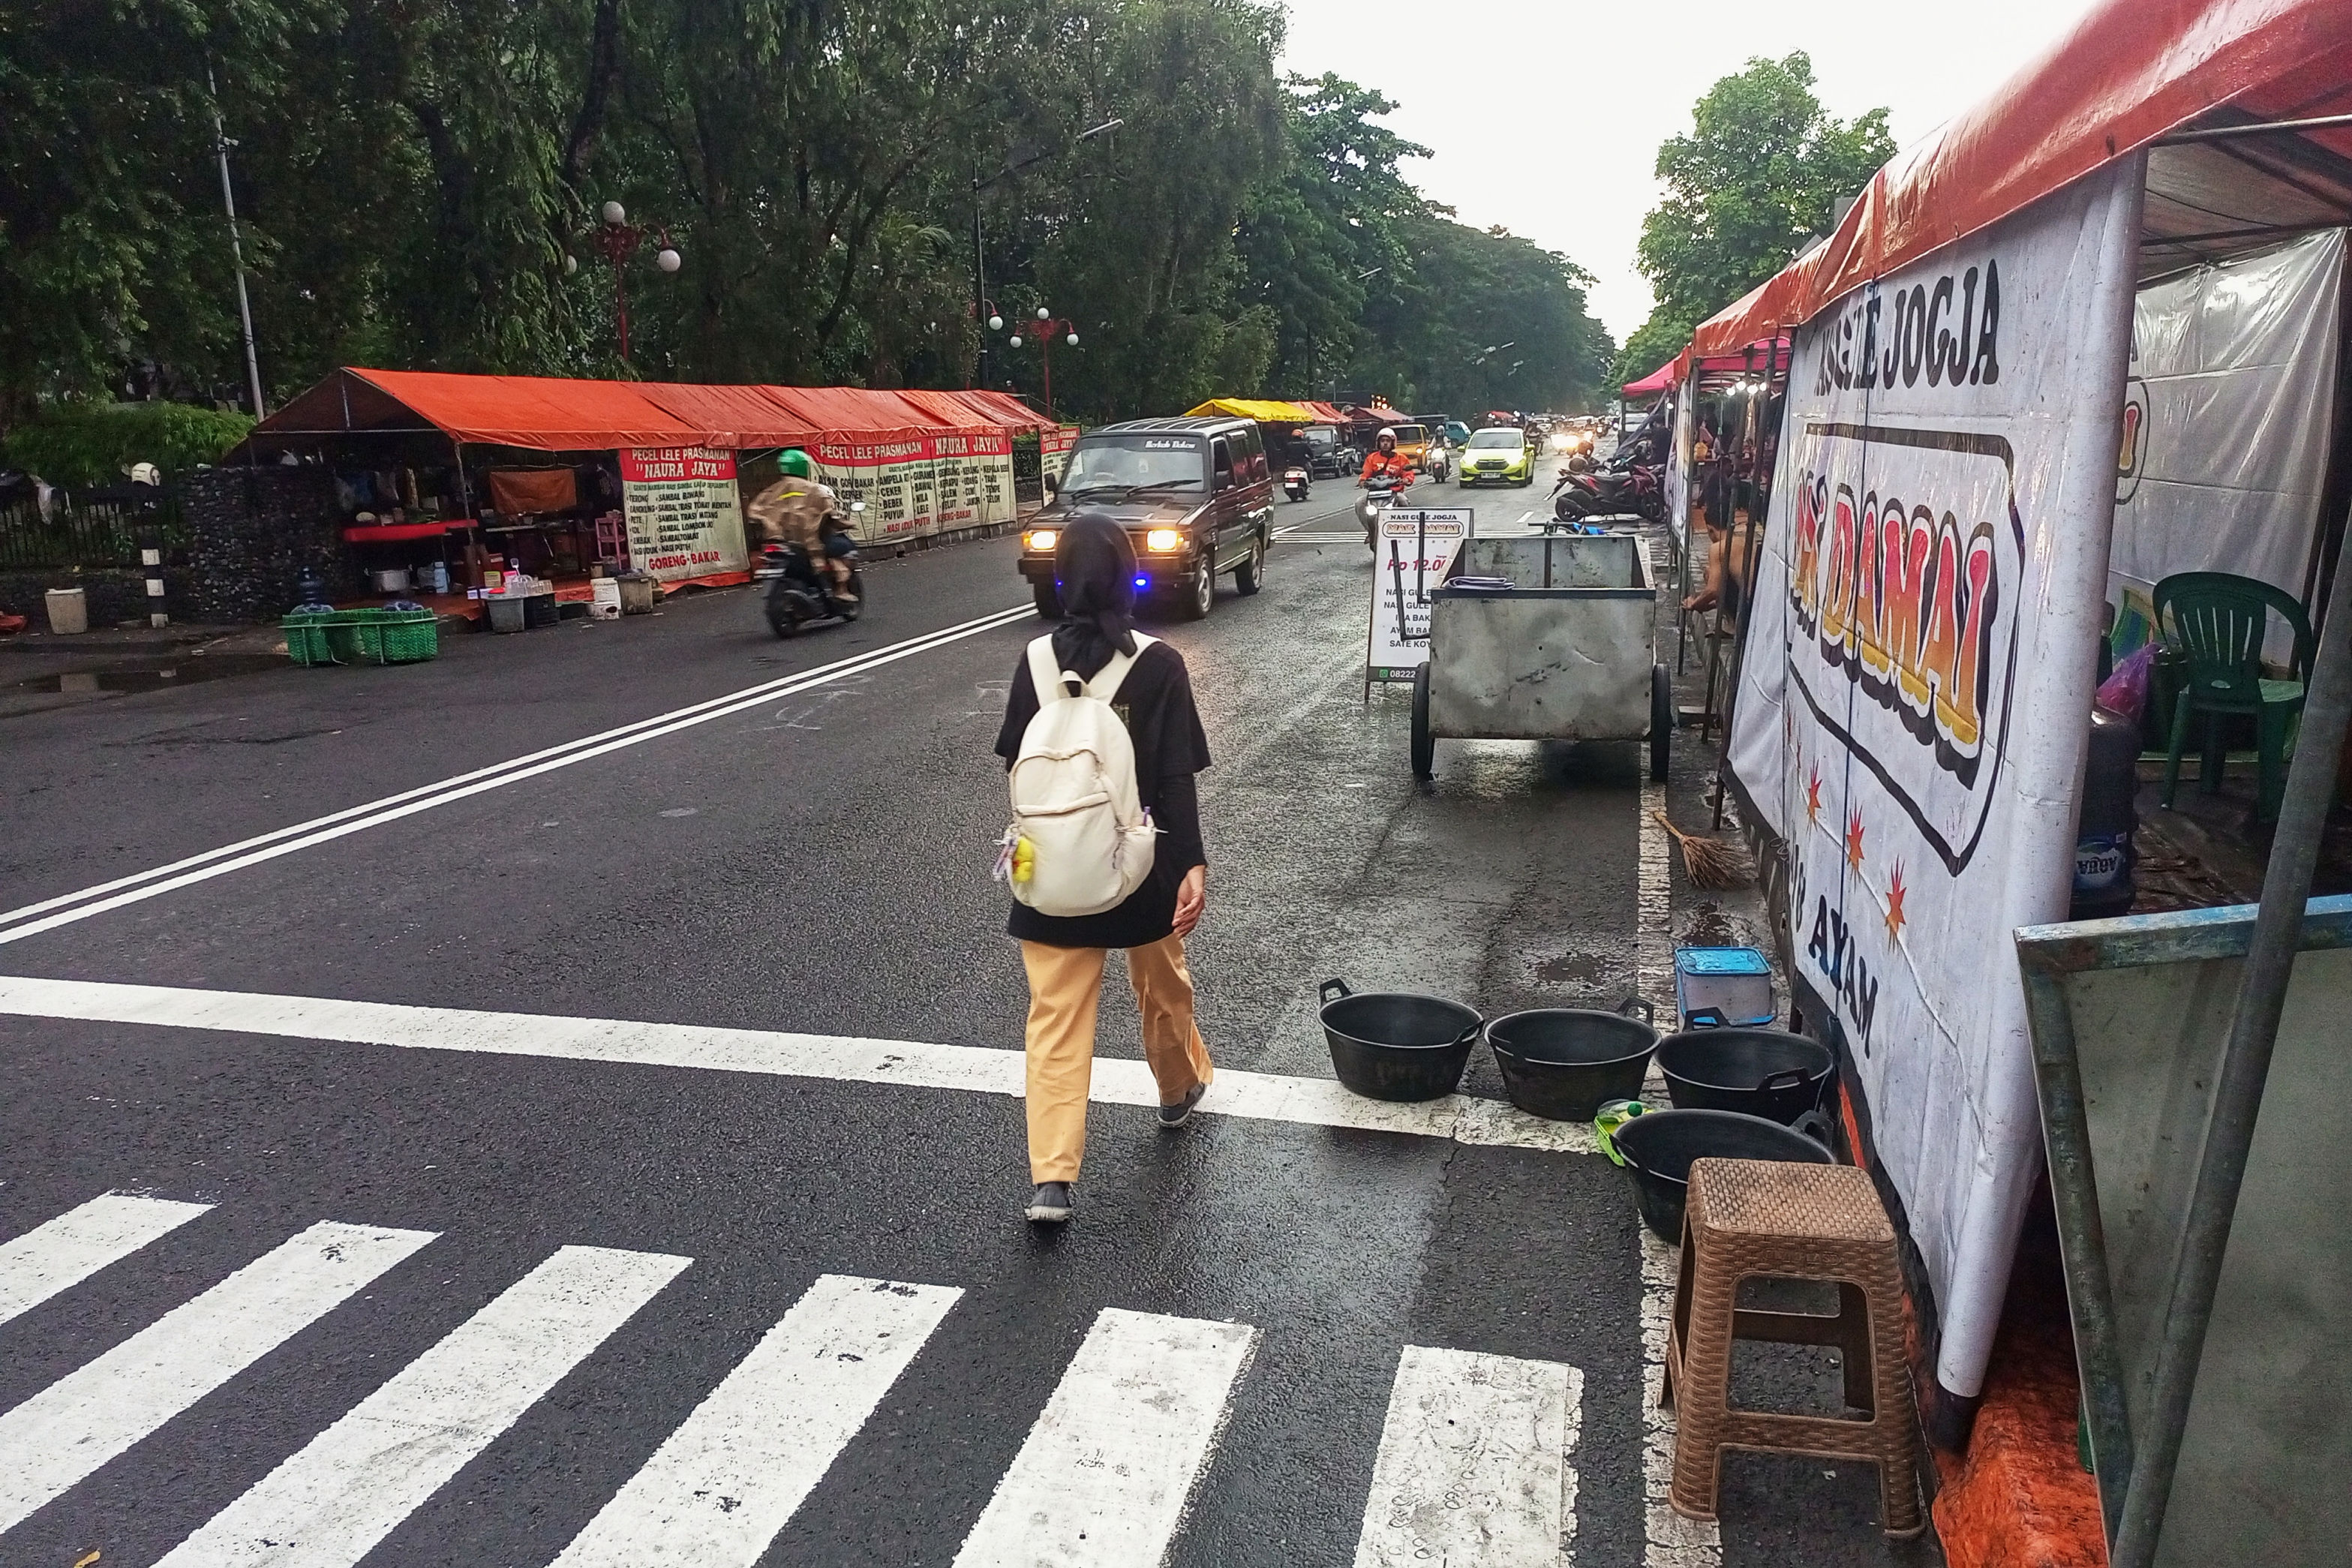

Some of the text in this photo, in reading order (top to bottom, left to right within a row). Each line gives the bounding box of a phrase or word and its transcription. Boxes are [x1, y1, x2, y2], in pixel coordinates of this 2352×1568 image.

[1883, 258, 2000, 390] JOGJA
[632, 447, 729, 461] PECEL LELE PRASMANAN
[820, 444, 849, 459] PECEL
[852, 446, 873, 459] LELE
[875, 441, 922, 458] PRASMANAN
[879, 474, 903, 486] AMPELA
[881, 486, 901, 497] CEKER
[915, 482, 933, 492] BAWAL
[659, 491, 704, 501] SAMBAL BAWANG
[916, 493, 928, 503] NILA
[986, 494, 1000, 503] TELOR
[658, 503, 677, 512] SAMBAL
[883, 497, 903, 509] BEBEK
[884, 509, 904, 520] PUYUH
[917, 503, 929, 515] LELE
[658, 514, 679, 522] SAMBAL
[659, 524, 680, 533] SAMBAL
[682, 521, 705, 530] LOMBOK
[887, 523, 900, 533] NASI
[1386, 524, 1416, 534] MAK
[659, 533, 699, 542] SAMBAL TOMAT
[675, 543, 690, 551] PUTIH
[649, 551, 720, 570] GORENG BAKAR
[1821, 482, 1999, 791] DAMAI
[1389, 670, 1416, 678] 08222
[1808, 894, 1878, 1059] AYAM
